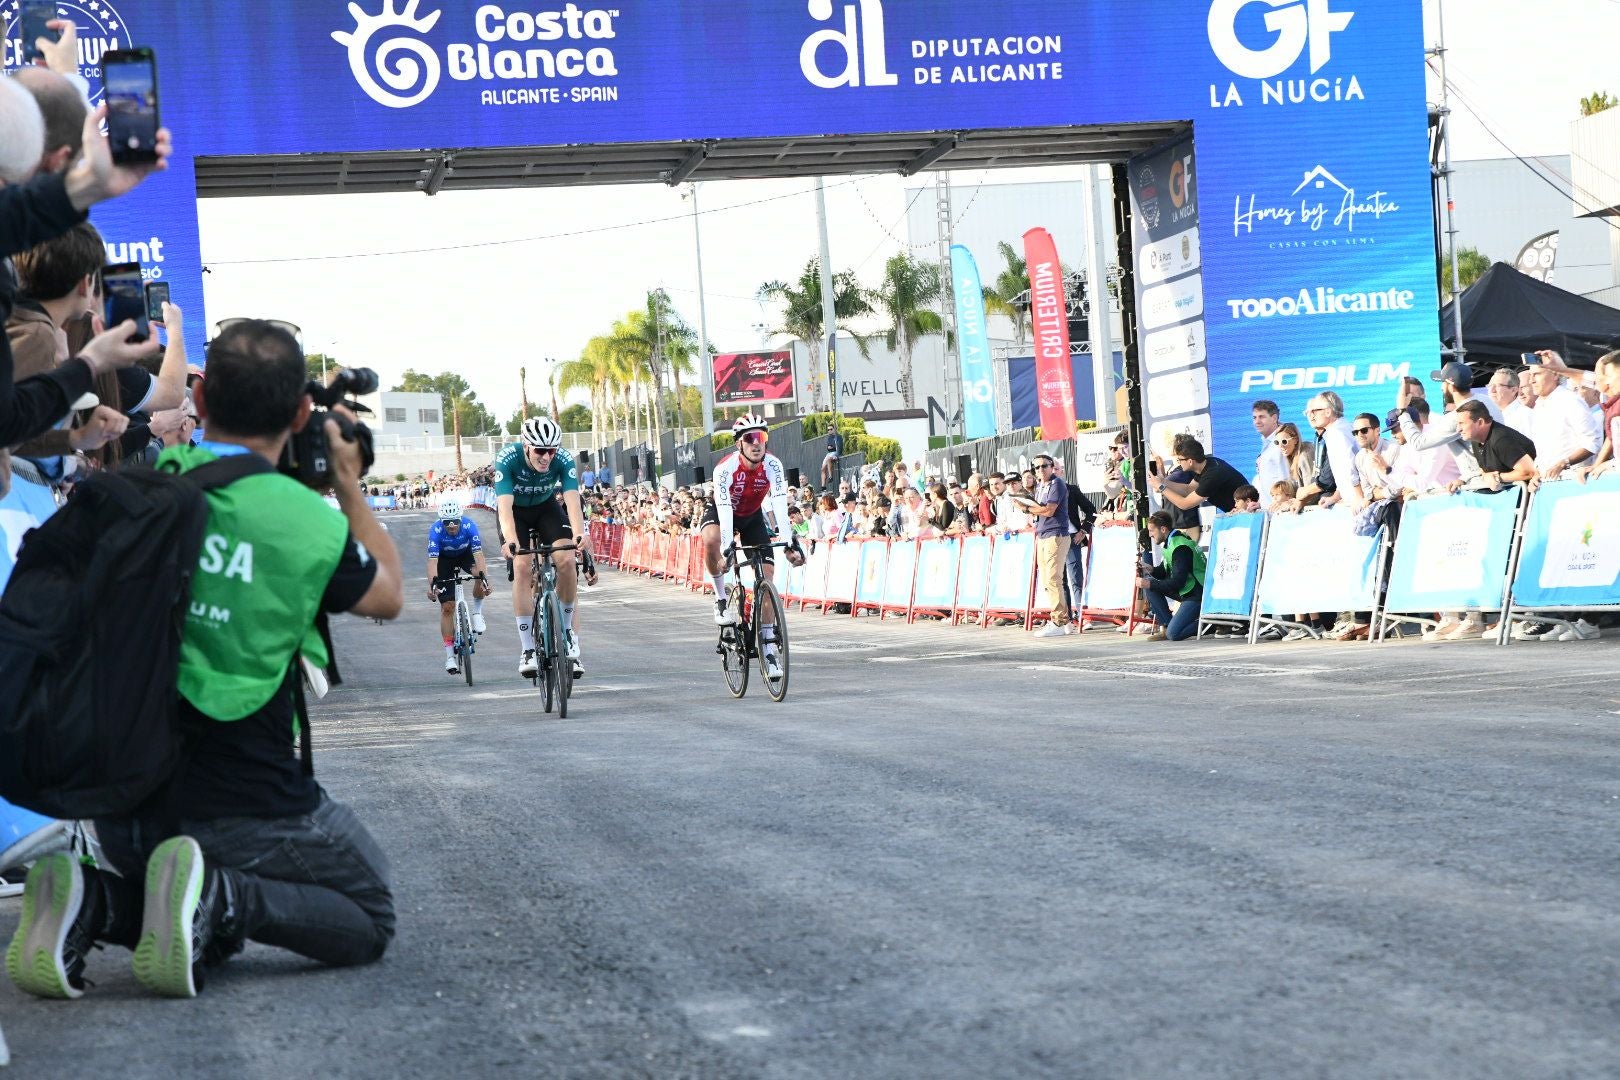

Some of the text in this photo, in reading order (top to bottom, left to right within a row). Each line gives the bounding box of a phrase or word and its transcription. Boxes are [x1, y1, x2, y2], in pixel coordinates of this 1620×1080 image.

[911, 36, 1061, 58] DIPUTACION
[447, 43, 618, 80] Blanca
[914, 63, 1063, 84] DE ALICANTE
[481, 86, 618, 105] ALICANTE SPAIN
[1210, 82, 1243, 108] LA
[1233, 193, 1296, 238] Homes
[1301, 199, 1328, 231] by
[1314, 239, 1337, 247] CON
[1239, 361, 1411, 393] PODIUM
